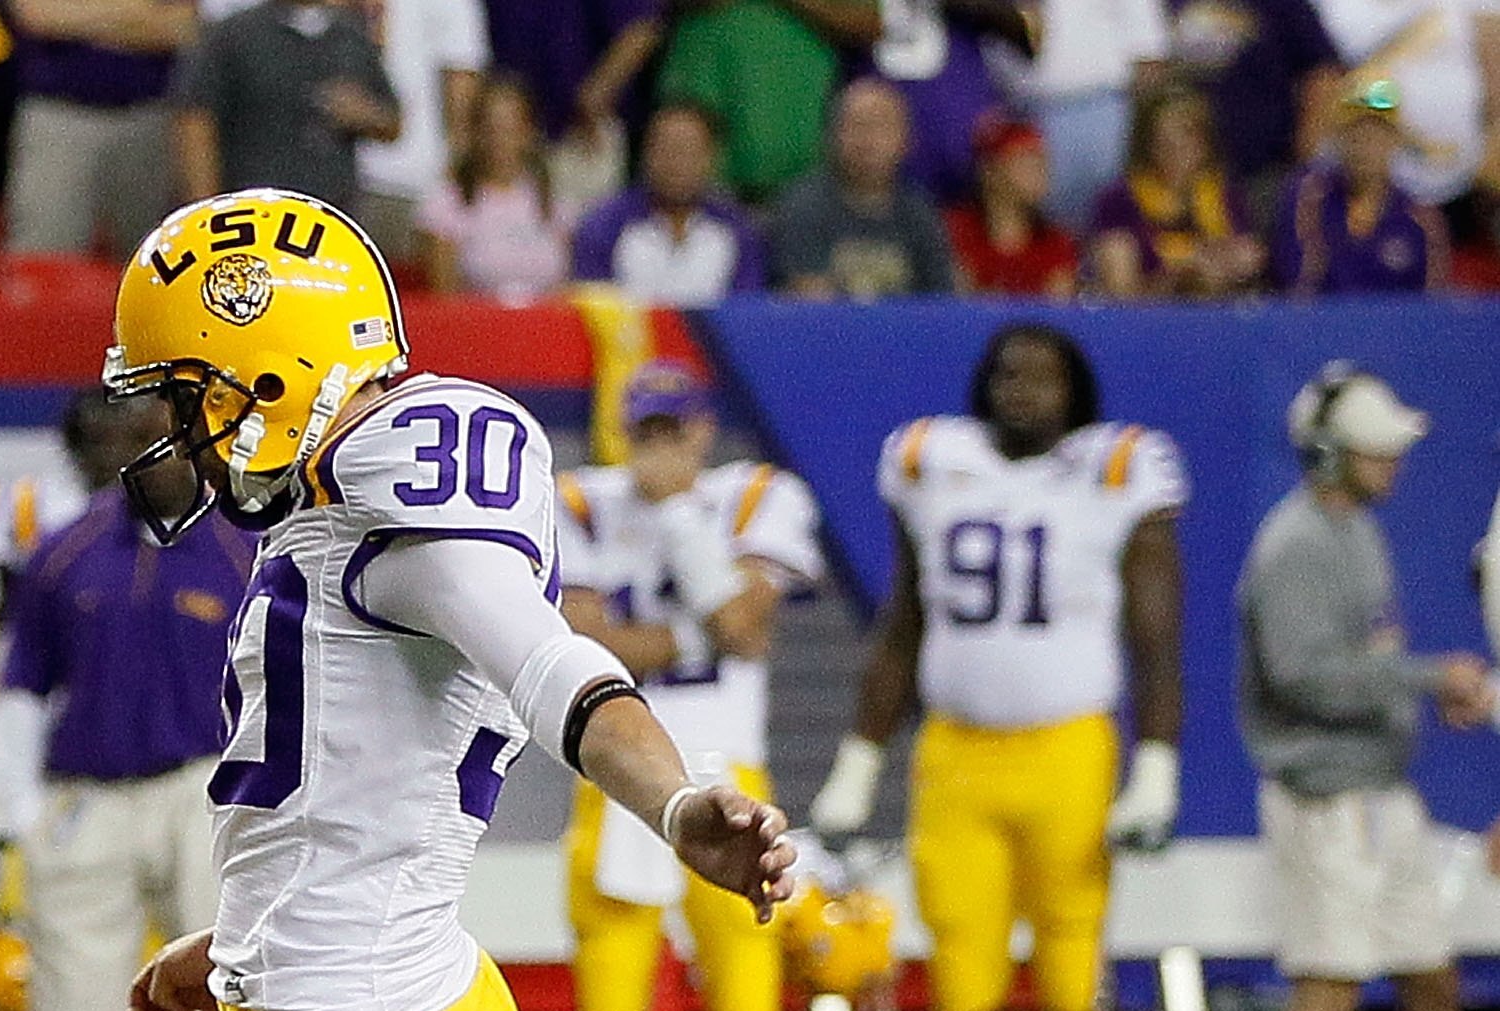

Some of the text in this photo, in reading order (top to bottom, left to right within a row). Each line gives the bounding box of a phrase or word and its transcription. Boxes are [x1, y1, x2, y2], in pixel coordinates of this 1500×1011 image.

[151, 208, 326, 287] LSU
[391, 402, 528, 510] 30
[945, 520, 1049, 629] 91
